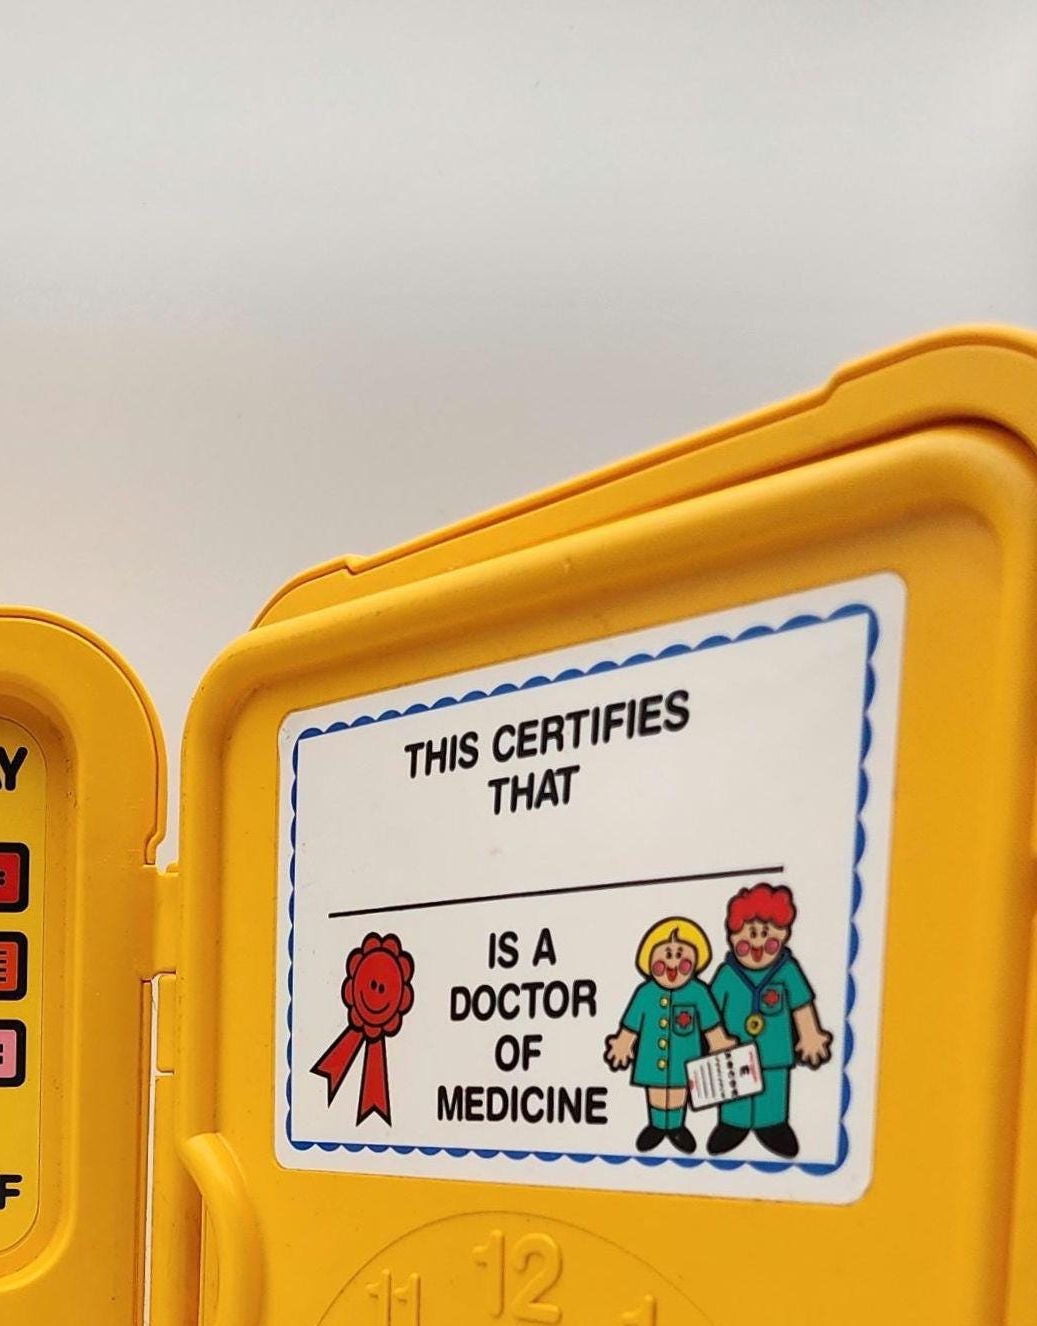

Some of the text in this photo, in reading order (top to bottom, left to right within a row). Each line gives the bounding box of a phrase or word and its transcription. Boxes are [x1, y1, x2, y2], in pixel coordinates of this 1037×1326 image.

[404, 688, 691, 779] THIS CERTIFIES
[486, 764, 581, 817] THAT
[487, 926, 558, 971] IS A
[449, 978, 599, 1023] DOCTOR
[493, 1033, 544, 1073] OF
[436, 1084, 610, 1126] MEDICINE
[471, 1229, 563, 1325] 12
